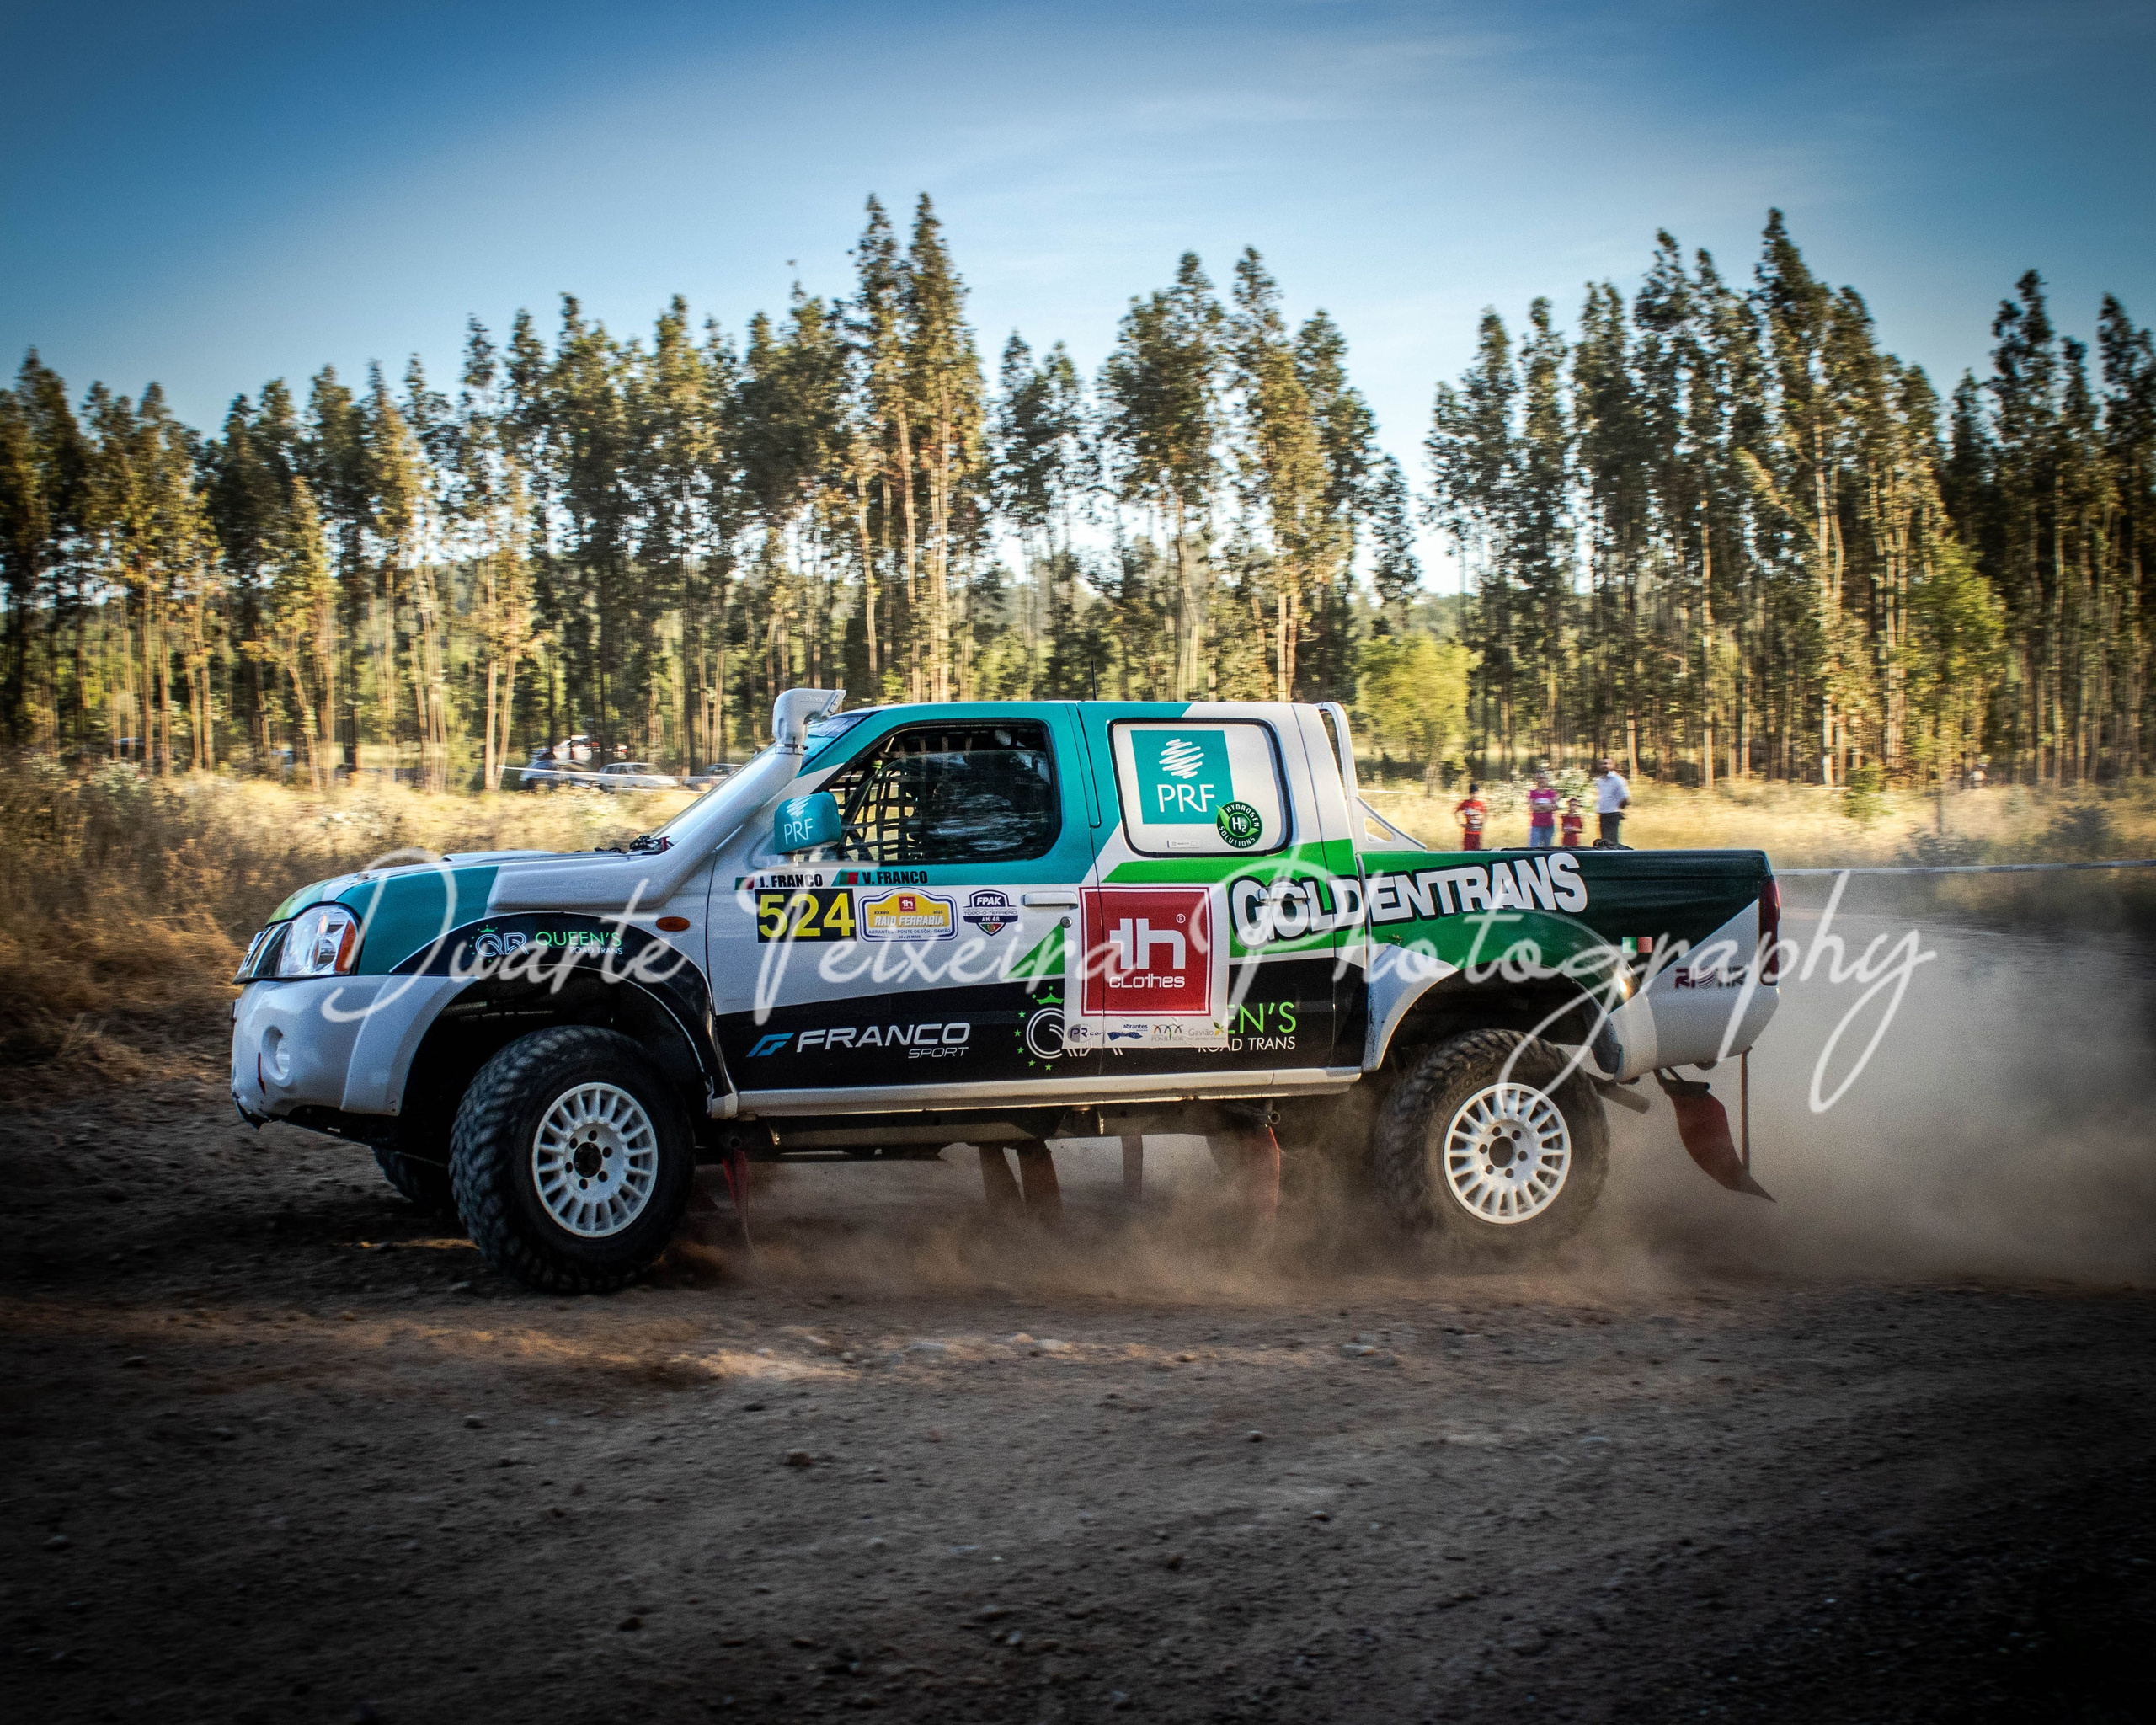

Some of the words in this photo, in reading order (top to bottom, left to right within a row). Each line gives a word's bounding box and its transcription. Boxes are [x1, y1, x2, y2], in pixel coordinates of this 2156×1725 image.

[1157, 784, 1215, 812] PRF
[1225, 804, 1260, 827] HYDROGEN
[784, 818, 813, 845] PRF
[1219, 825, 1256, 847] SOLUTIONS
[771, 874, 824, 888] FRANCO
[862, 871, 876, 884] V.
[880, 870, 928, 884] FRANCO
[976, 896, 1002, 905] FPAK
[1231, 852, 1588, 947] GOLDENTRANS
[758, 893, 855, 938] 524
[874, 916, 897, 927] RAID
[899, 916, 945, 927] FERRARIA
[535, 931, 622, 948] QUEEN'S
[569, 946, 595, 954] ROAD
[595, 947, 623, 955] TRANS
[797, 1023, 970, 1053] FRANCO
[1248, 1036, 1296, 1051] TRANS
[908, 1046, 969, 1059] SPORT
